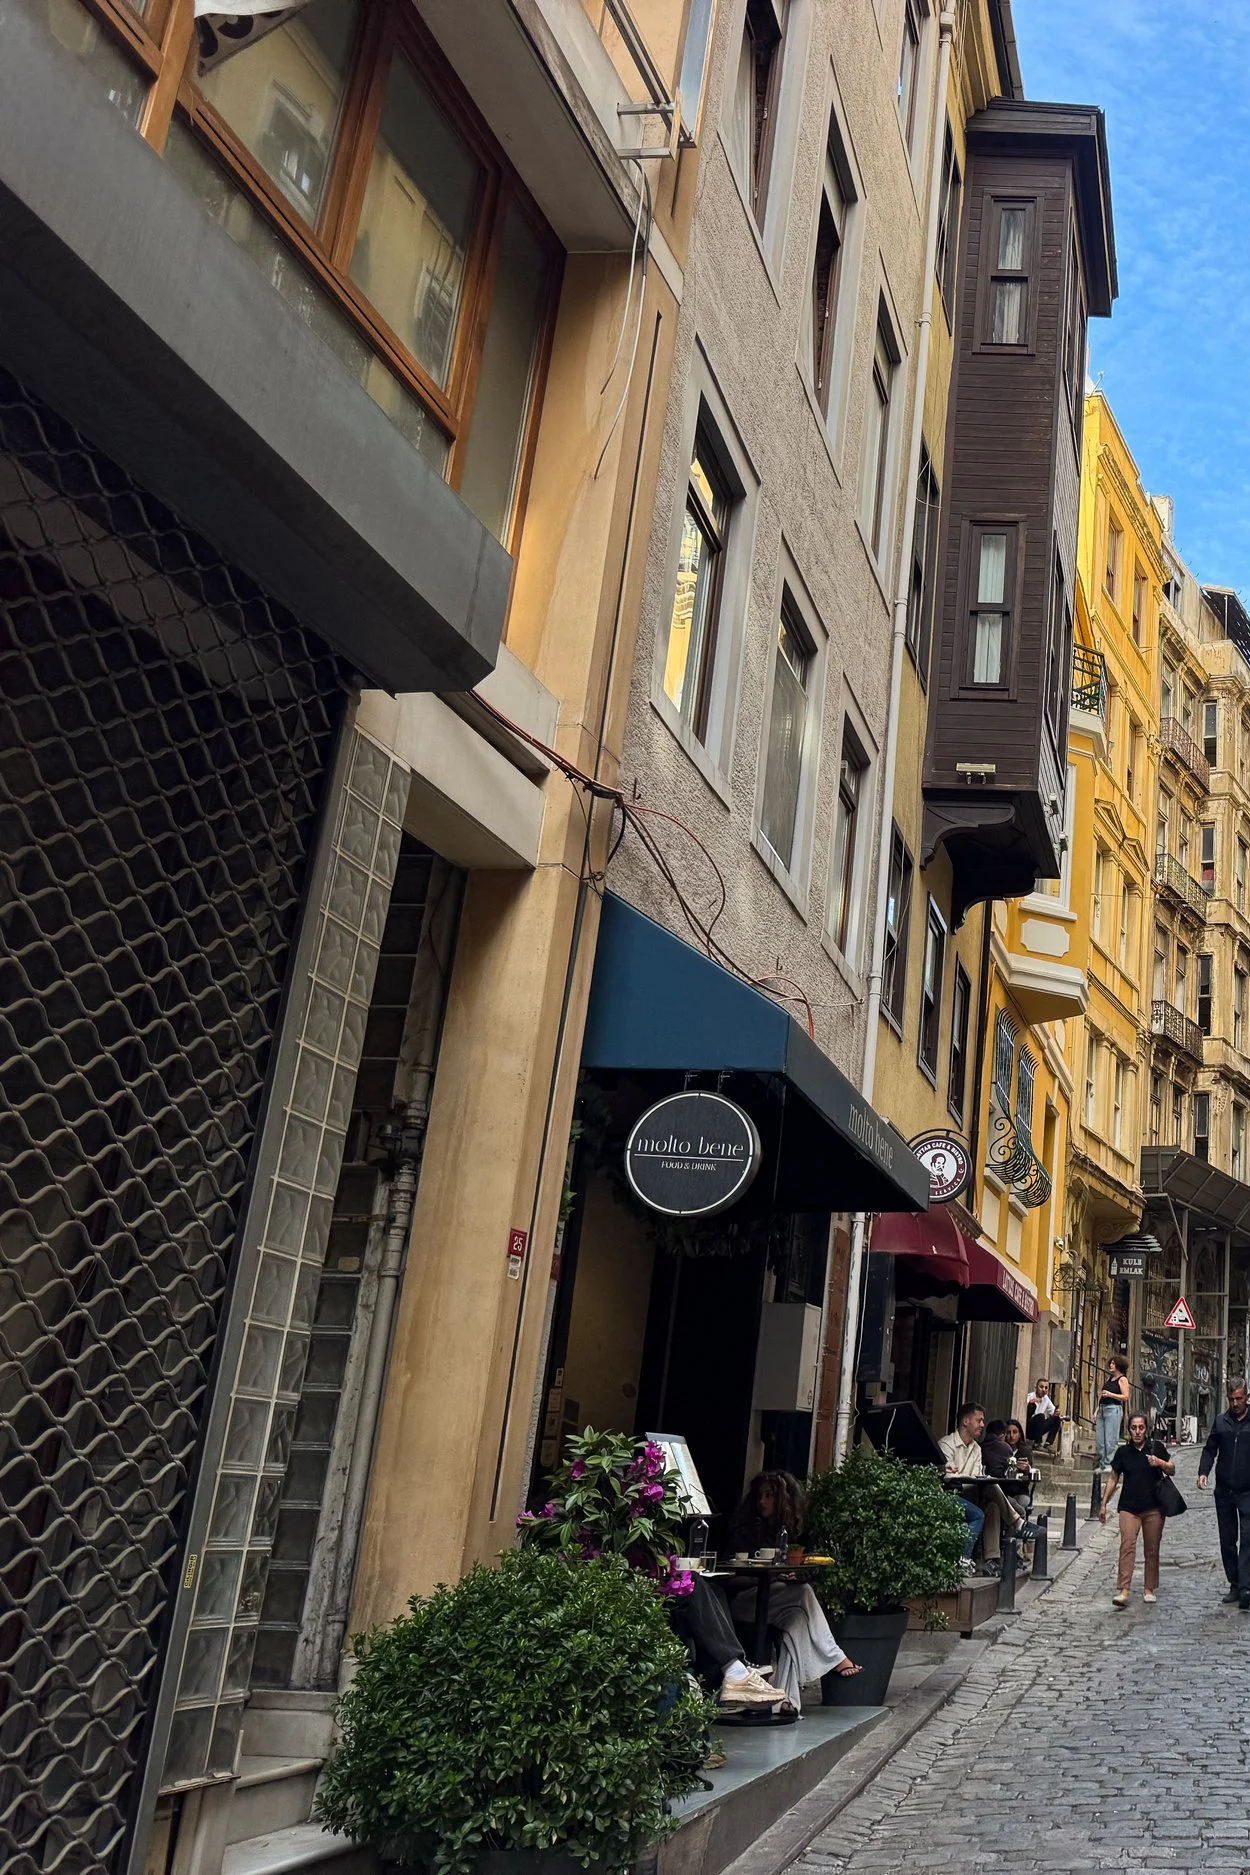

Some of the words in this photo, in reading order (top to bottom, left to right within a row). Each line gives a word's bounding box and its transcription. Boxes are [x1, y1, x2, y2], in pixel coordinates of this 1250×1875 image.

[848, 1104, 874, 1149] molto
[875, 1121, 894, 1169] bene
[638, 1135, 691, 1154] molto
[698, 1136, 744, 1157] bene
[950, 1147, 964, 1165] BISTRO
[661, 1161, 683, 1170] FOOD
[683, 1162, 691, 1170] &
[691, 1162, 717, 1171] DRINK
[513, 1236, 523, 1251] 25
[1122, 1258, 1143, 1266] KULE
